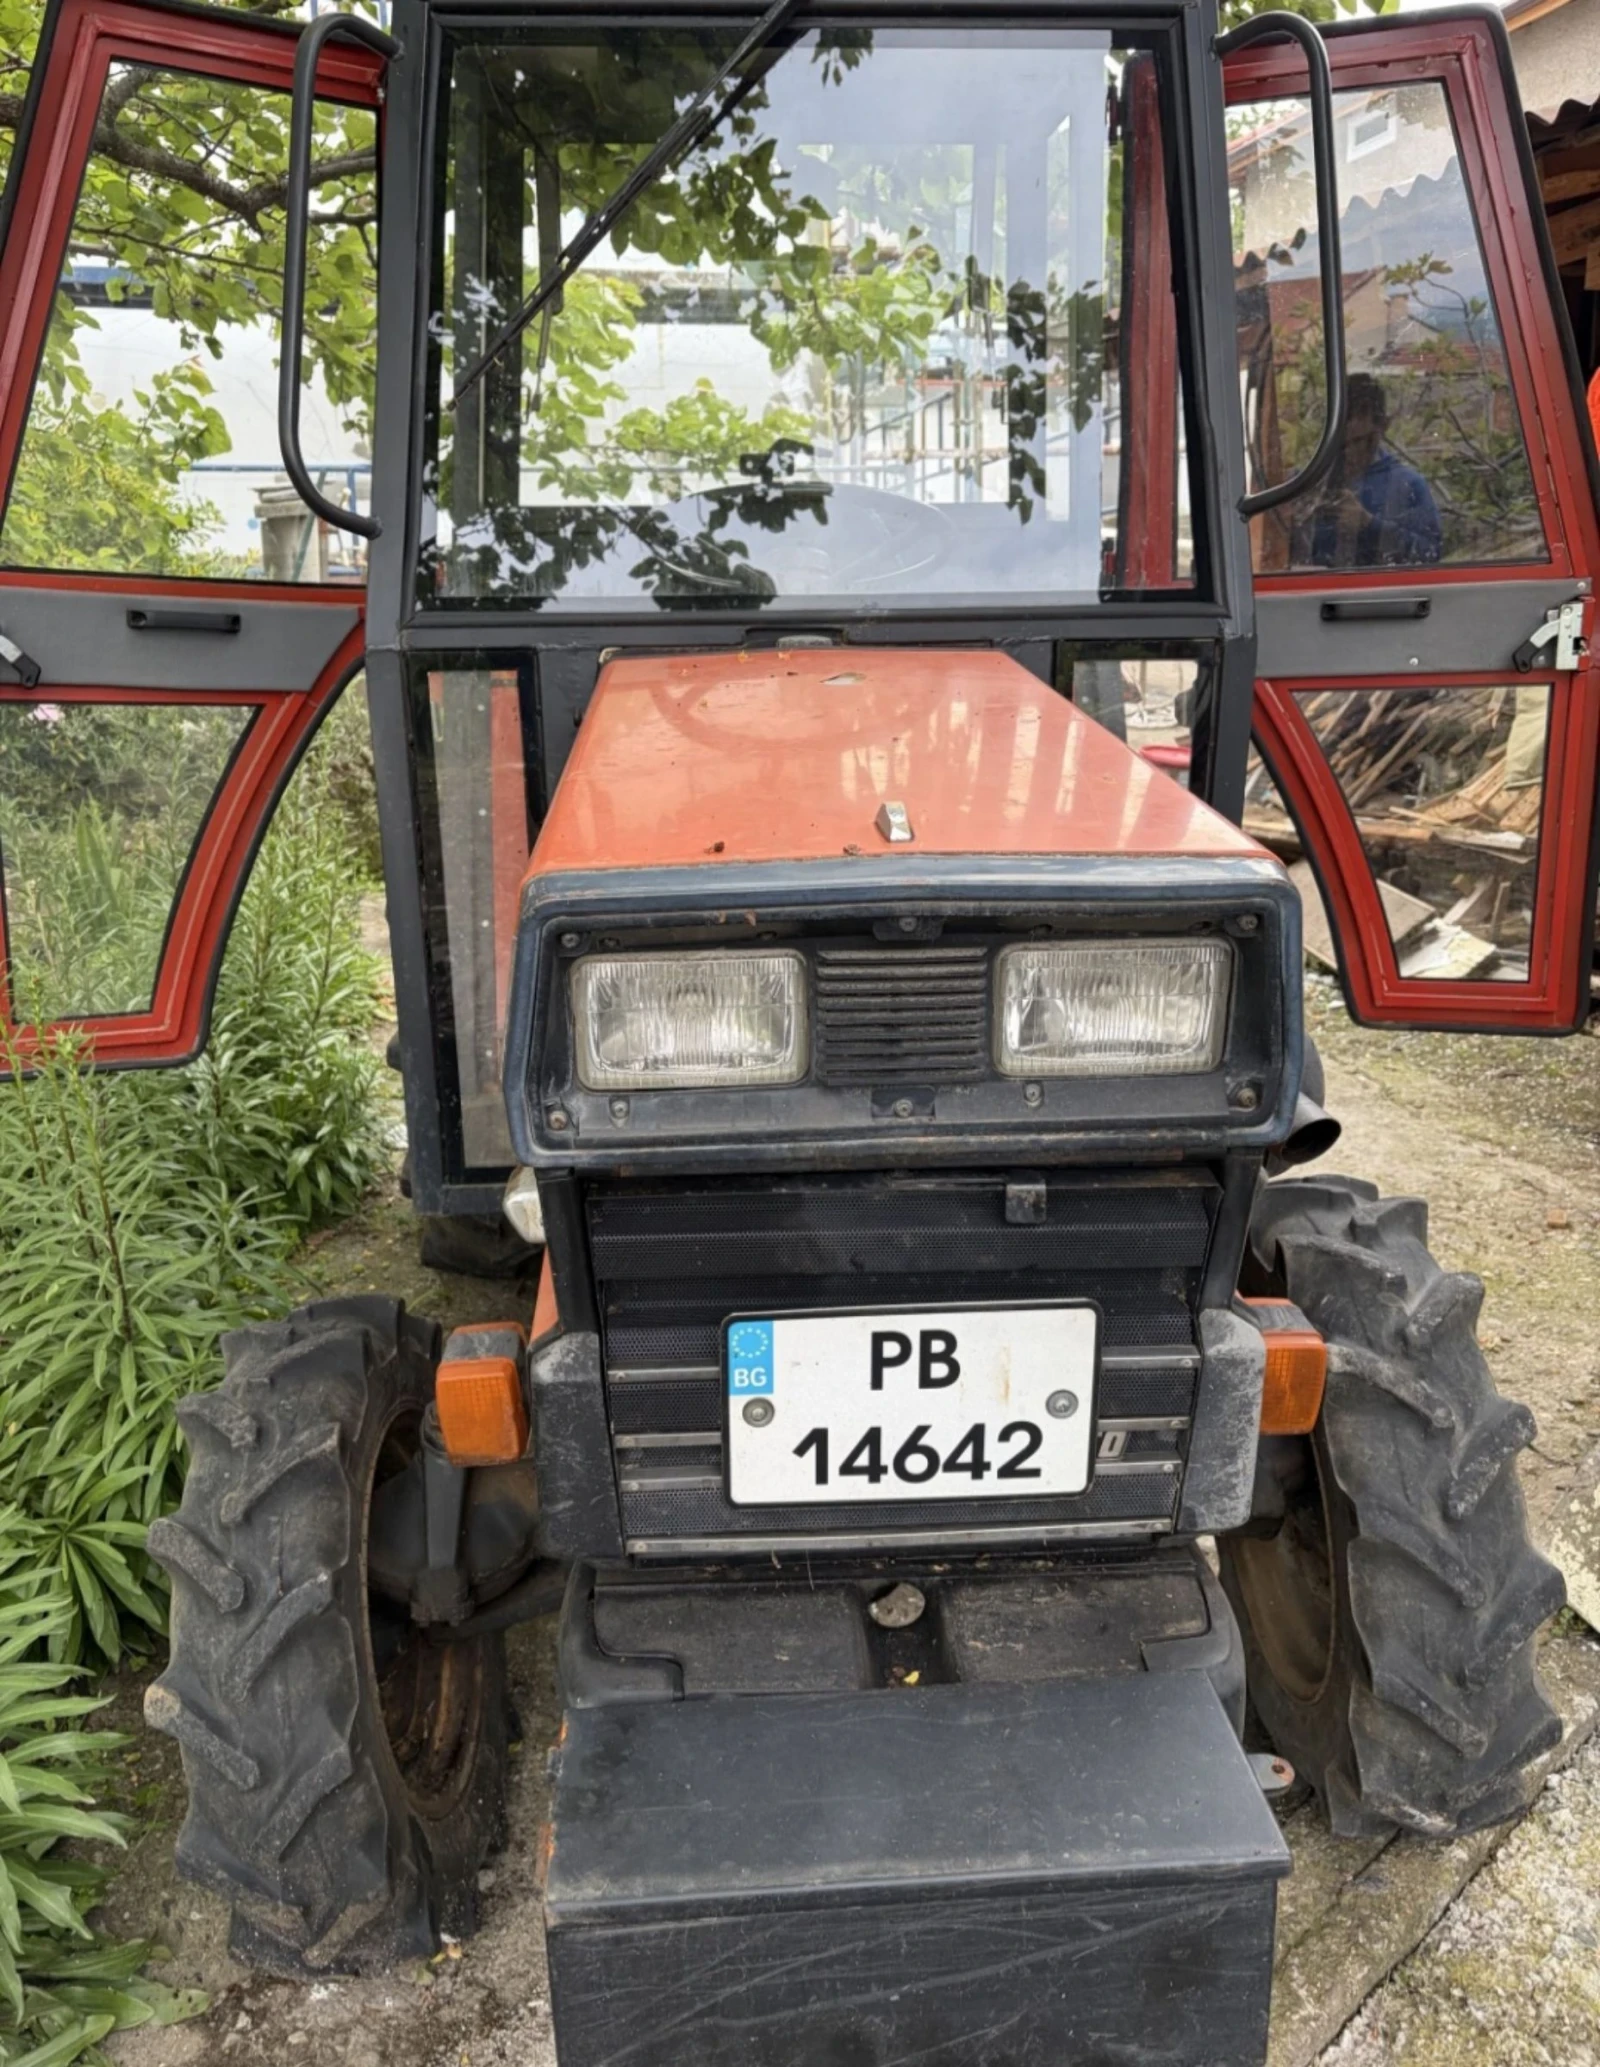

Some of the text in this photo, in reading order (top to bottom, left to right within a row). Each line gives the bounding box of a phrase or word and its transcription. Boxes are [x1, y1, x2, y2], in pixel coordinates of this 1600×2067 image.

[733, 1367, 767, 1388] BG
[870, 1329, 961, 1391] PB
[792, 1420, 1043, 1485] 14642
